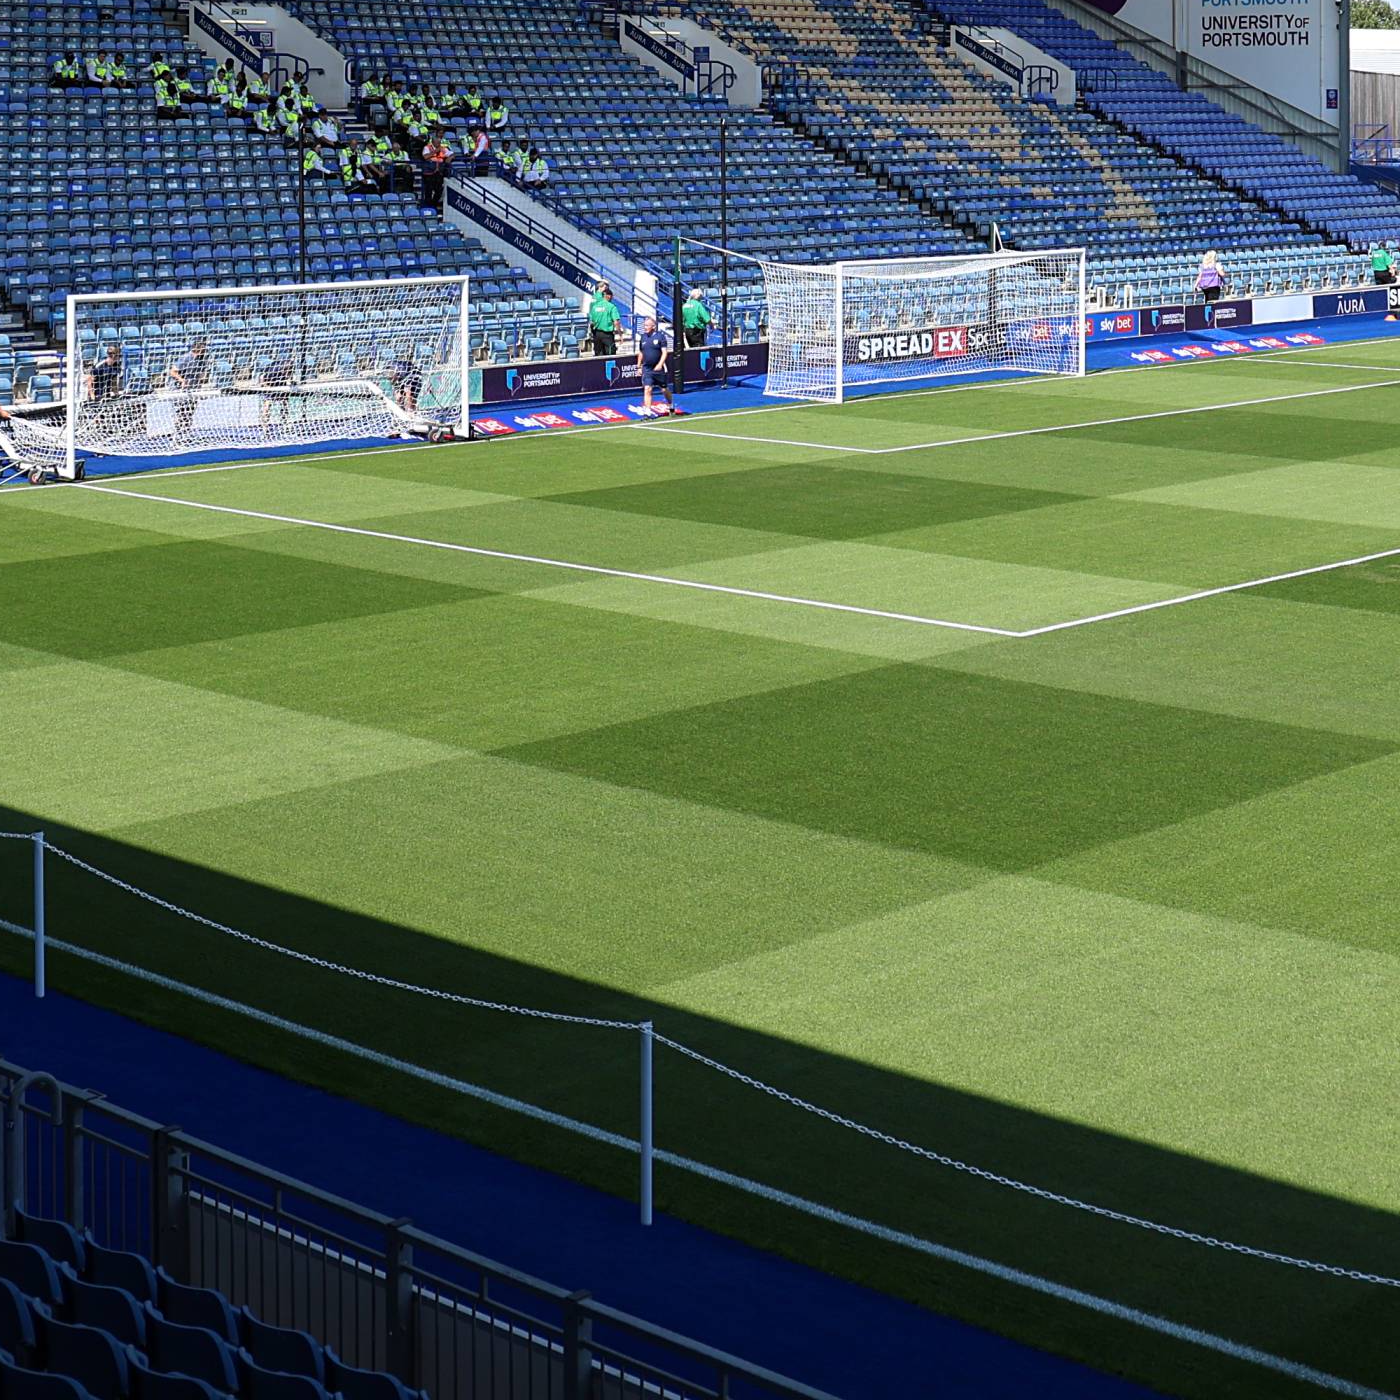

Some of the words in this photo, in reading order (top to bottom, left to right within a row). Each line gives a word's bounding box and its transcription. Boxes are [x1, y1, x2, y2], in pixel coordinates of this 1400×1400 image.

[1202, 14, 1294, 30] UNIVERSITY
[1295, 18, 1310, 29] OF
[1203, 31, 1309, 47] PORTSMOUTH
[1100, 318, 1115, 333] sky
[1117, 316, 1132, 329] bet
[523, 372, 555, 381] UNIVERSITY
[523, 378, 560, 388] PORTSMOUTH
